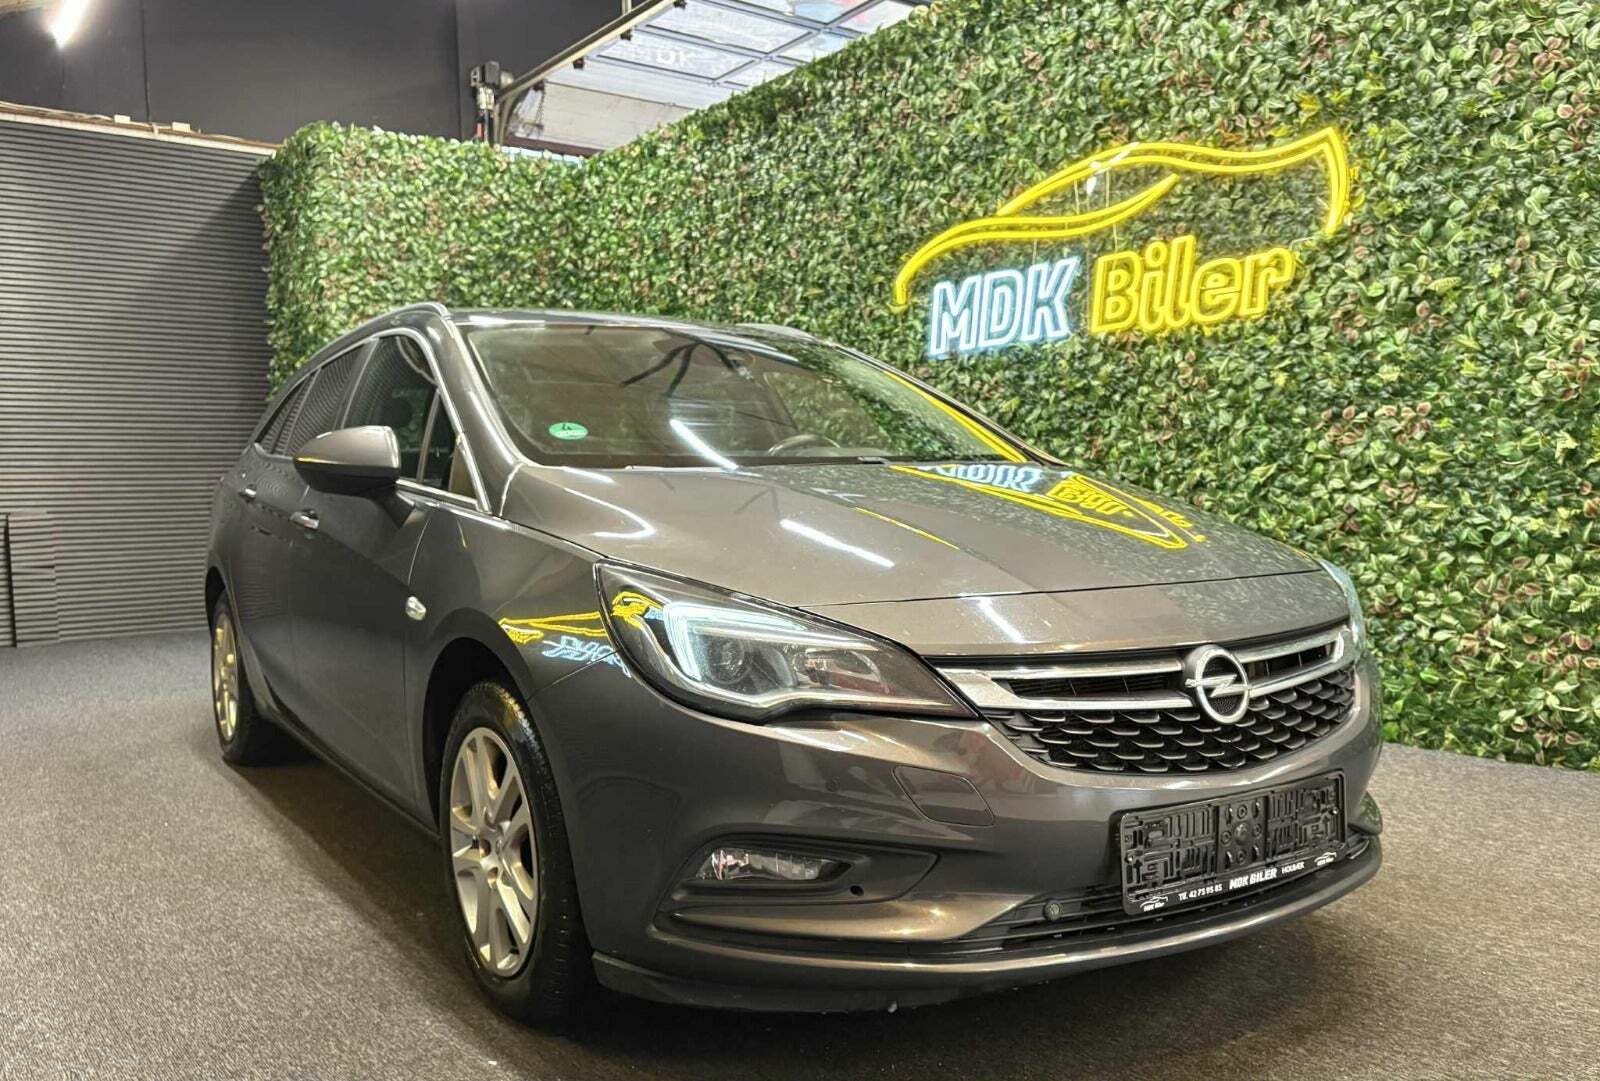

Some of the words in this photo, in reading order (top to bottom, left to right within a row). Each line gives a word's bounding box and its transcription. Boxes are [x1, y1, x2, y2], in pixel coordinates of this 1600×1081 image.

[929, 256, 1081, 358] MDK
[1090, 235, 1298, 334] Biler
[1229, 876, 1249, 889] MDK
[1249, 868, 1277, 884] BILER
